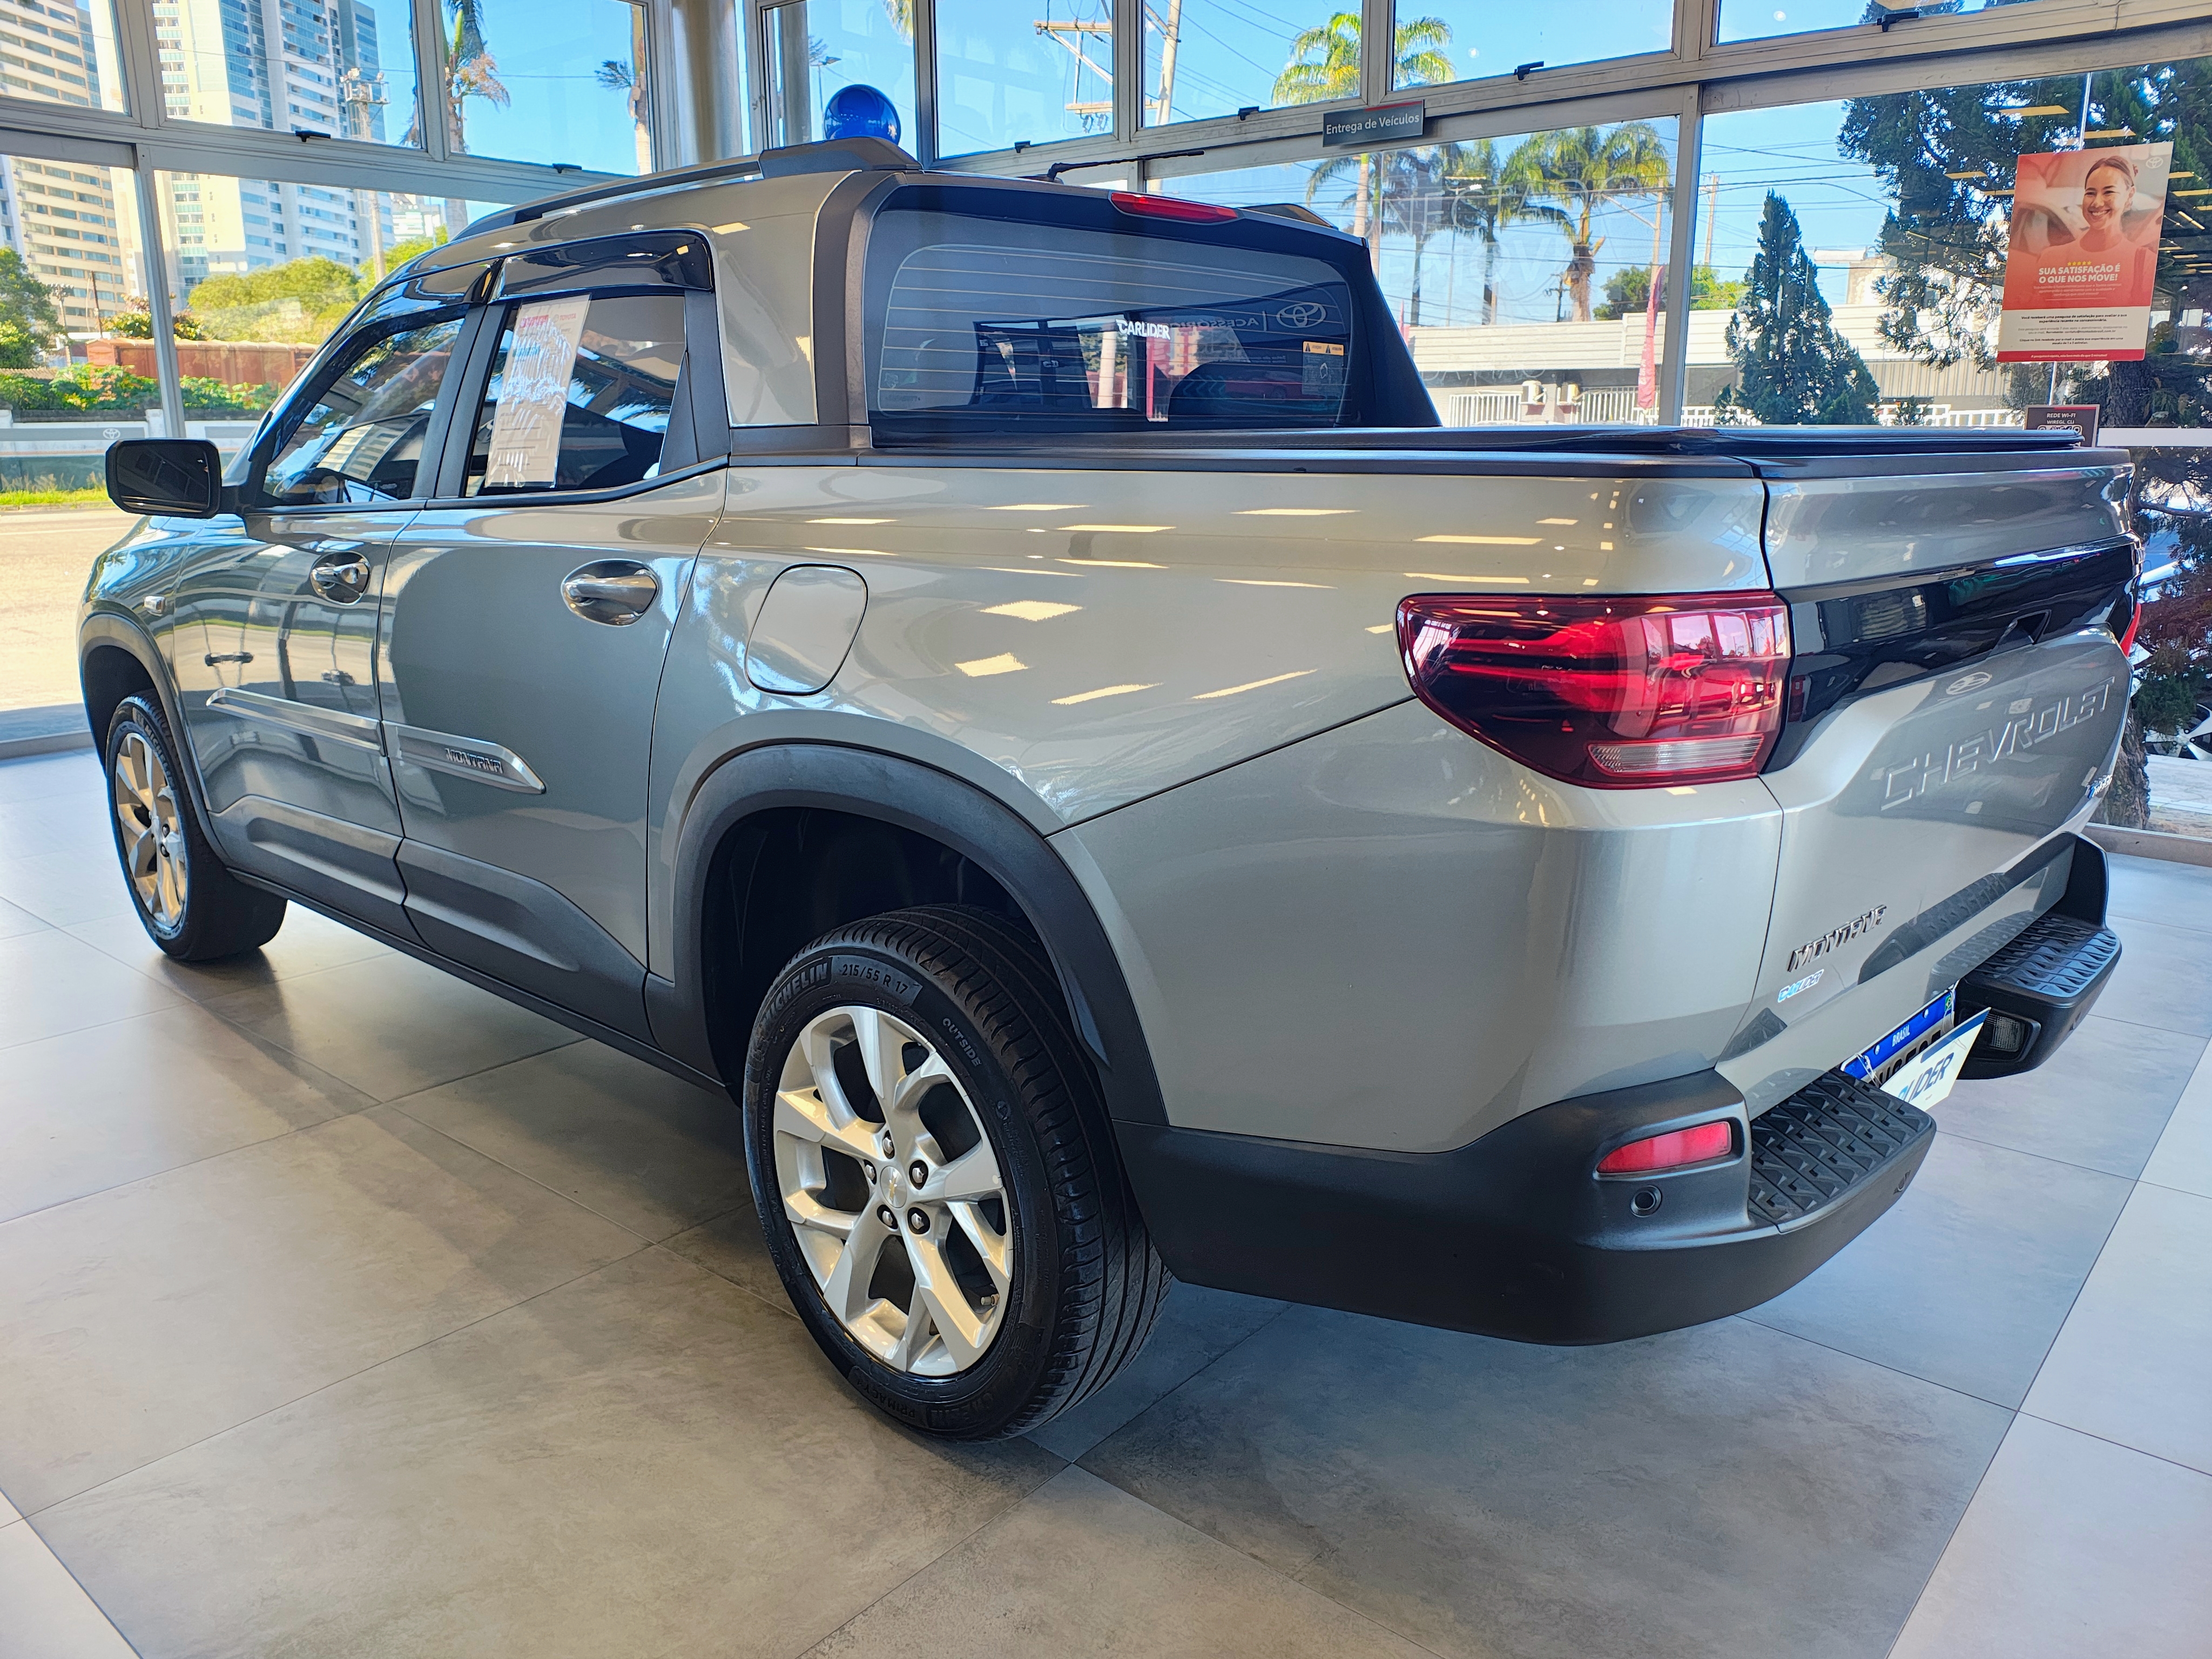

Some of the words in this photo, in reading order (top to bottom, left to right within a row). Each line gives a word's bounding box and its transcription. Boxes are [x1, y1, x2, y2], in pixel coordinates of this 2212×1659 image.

[1326, 123, 1363, 134] Entrega
[1365, 118, 1377, 130] de
[1379, 113, 1420, 127] Veículos
[2048, 275, 2066, 284] QUE
[2088, 274, 2118, 282] MOVE!
[2058, 264, 2113, 274] SATISFAÇÃO
[2115, 263, 2121, 272] É
[1115, 319, 1171, 340] CARLIDER
[1880, 676, 2115, 811] CHEVROLET
[444, 748, 504, 774] MONTANA
[1786, 904, 1887, 972] MONTANA
[765, 962, 828, 1021] MICHELIN
[841, 964, 880, 982] 215/55
[883, 975, 892, 988] R
[896, 981, 909, 995] 17
[942, 1017, 982, 1067] OUTSIDE
[1892, 1024, 1911, 1047] BRASIL
[864, 1385, 916, 1419] PRIMACY
